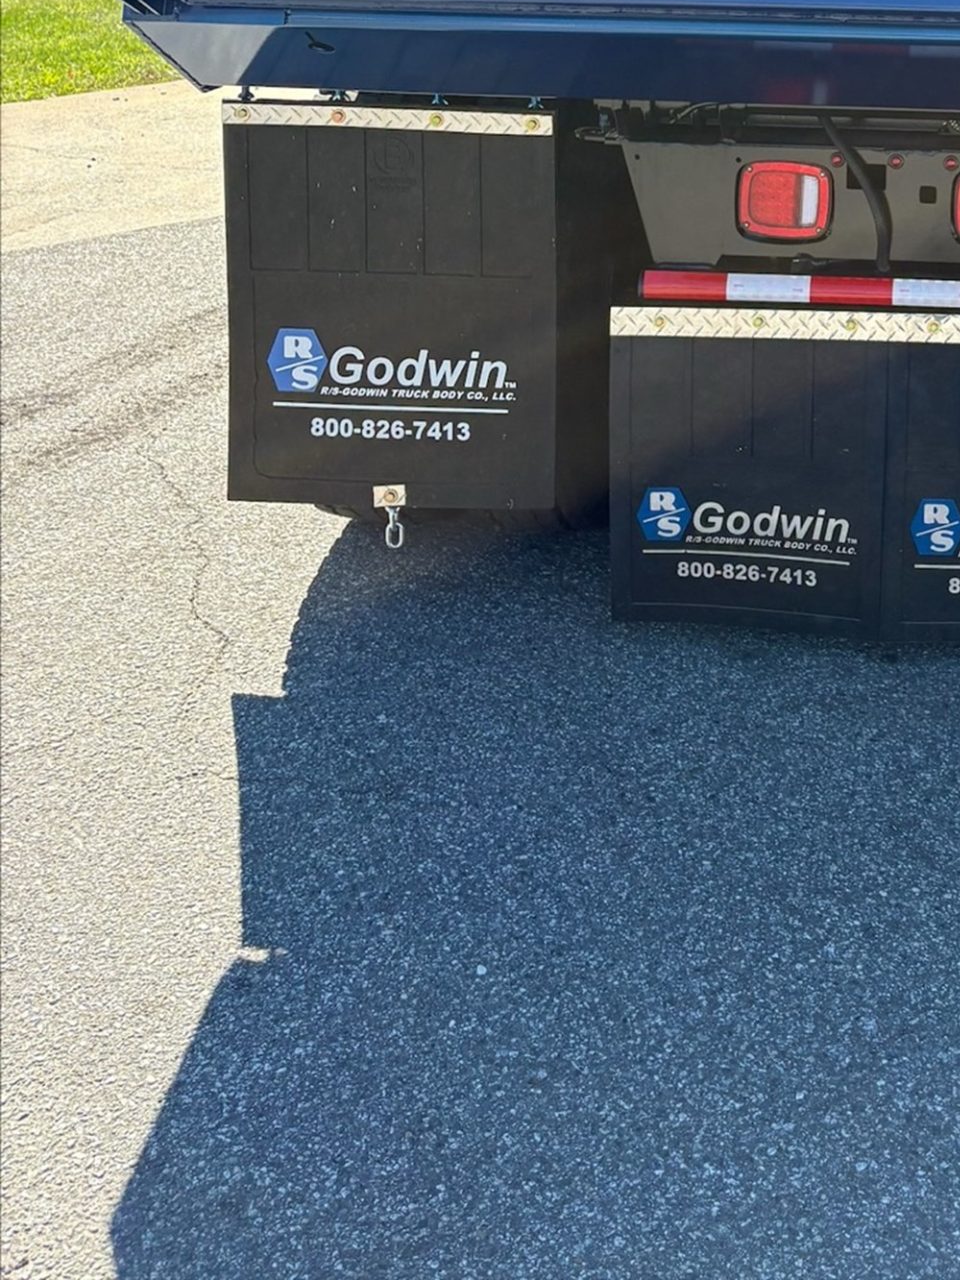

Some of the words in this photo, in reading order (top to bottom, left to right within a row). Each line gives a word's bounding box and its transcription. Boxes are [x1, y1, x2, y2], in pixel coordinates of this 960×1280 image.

[329, 346, 508, 389] Godwin
[391, 388, 429, 399] TRUCK
[432, 390, 464, 400] BODY
[310, 417, 471, 441] 800-826-7413
[693, 501, 850, 544] Godwin
[748, 538, 781, 548] TRUCK
[784, 541, 811, 550] BODY
[677, 561, 817, 587] 800-826-7413
